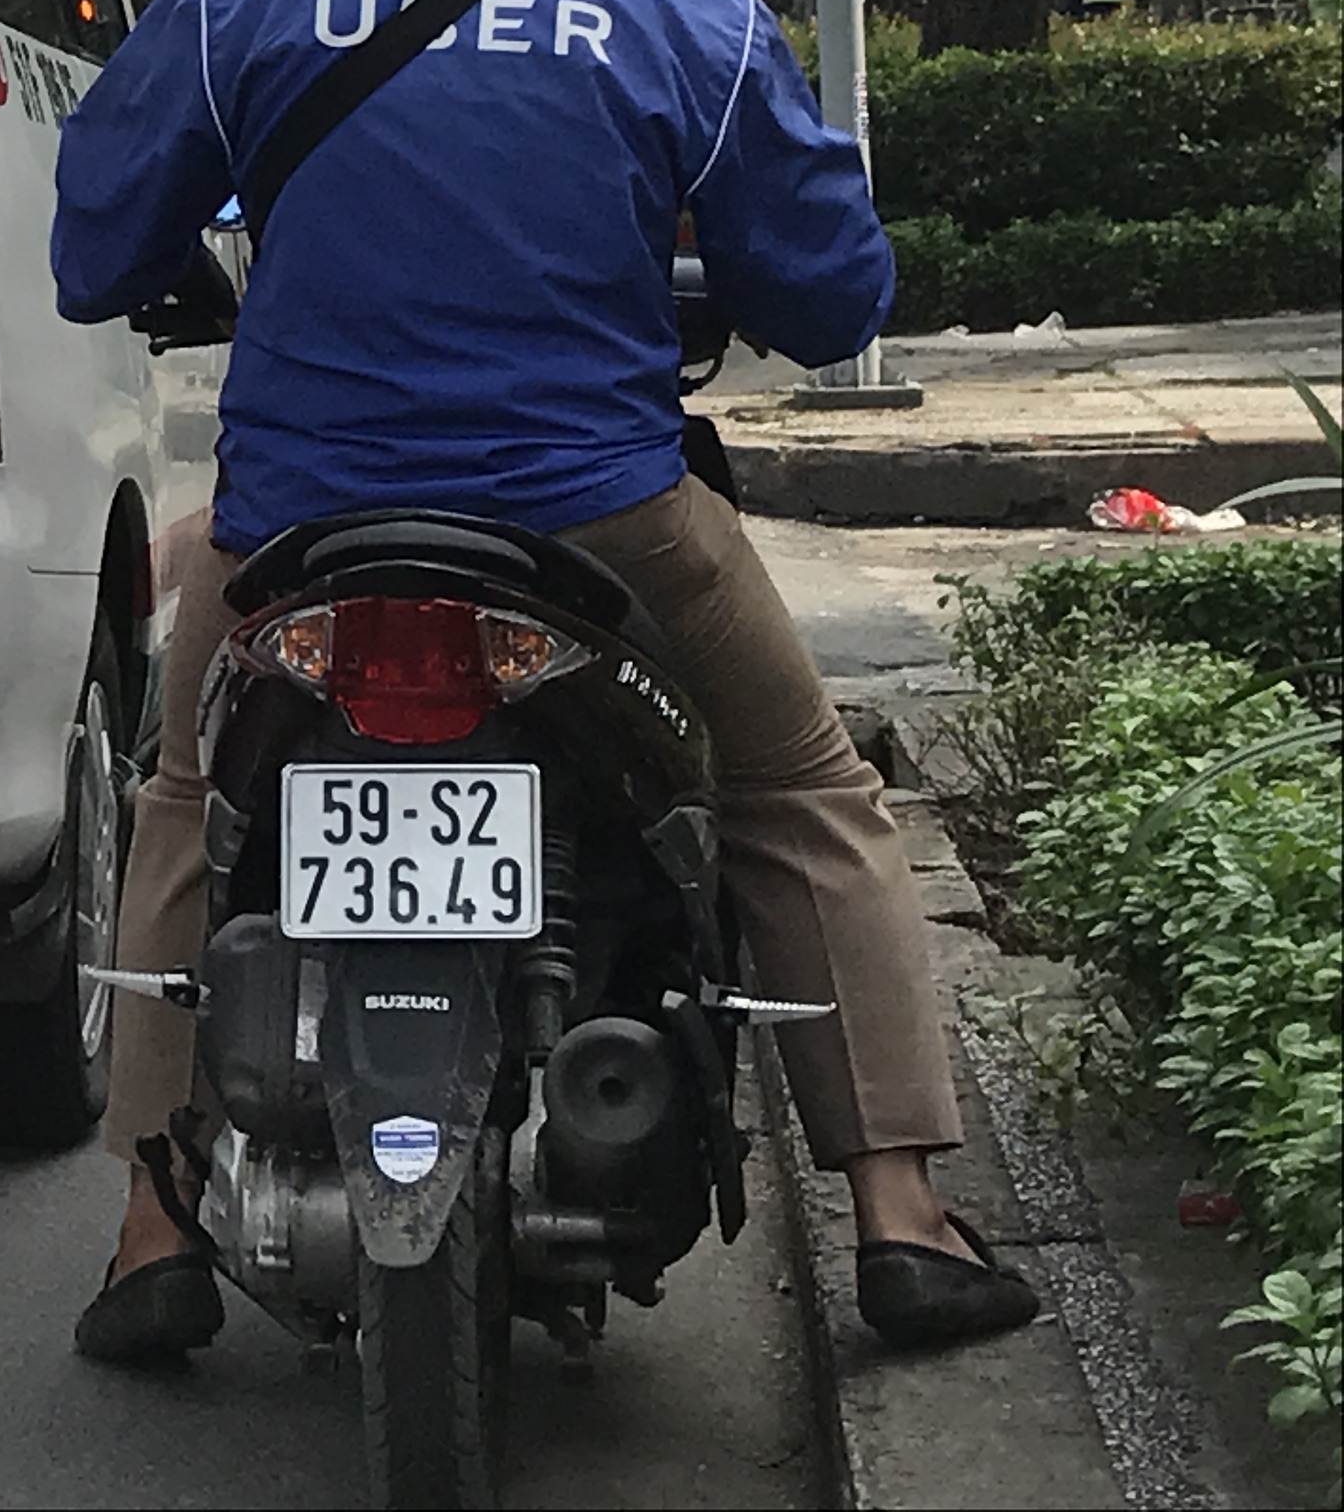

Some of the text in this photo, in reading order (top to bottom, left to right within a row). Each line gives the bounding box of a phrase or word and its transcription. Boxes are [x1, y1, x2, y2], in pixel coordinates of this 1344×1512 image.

[323, 780, 498, 846] 59-S2
[299, 857, 522, 924] 736.49
[365, 994, 450, 1010] SUZUKI
